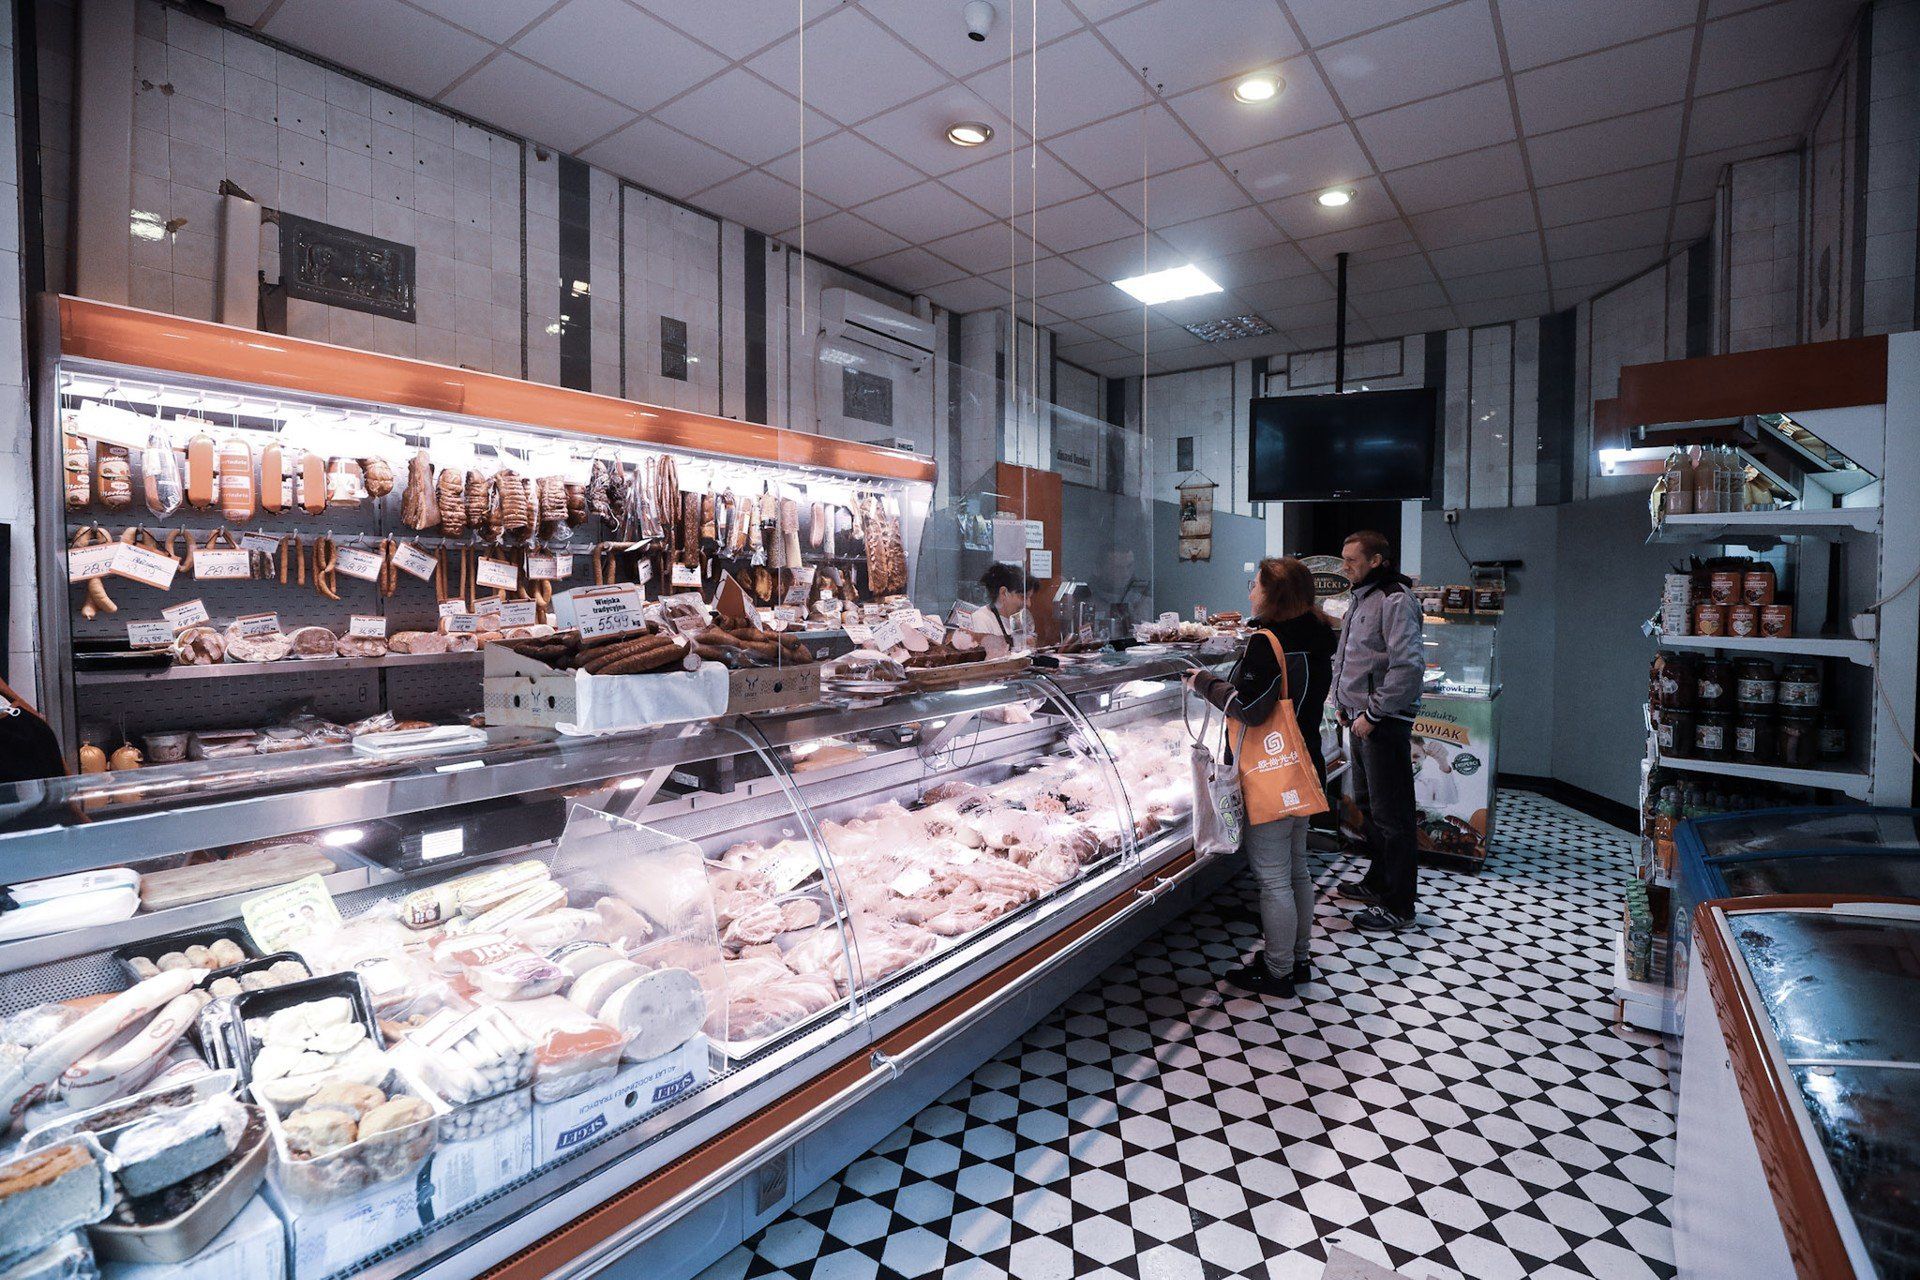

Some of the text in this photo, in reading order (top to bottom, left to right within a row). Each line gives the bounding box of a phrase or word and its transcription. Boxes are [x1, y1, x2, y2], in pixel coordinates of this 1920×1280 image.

[592, 604, 626, 614] tradycyjna
[594, 597, 620, 606] Wiejska
[1411, 722, 1461, 740] OWIAK
[654, 1069, 667, 1079] LAT
[656, 1074, 693, 1100] SEGET
[579, 1093, 613, 1114] TRADYCJI
[561, 1116, 605, 1146] SEGET
